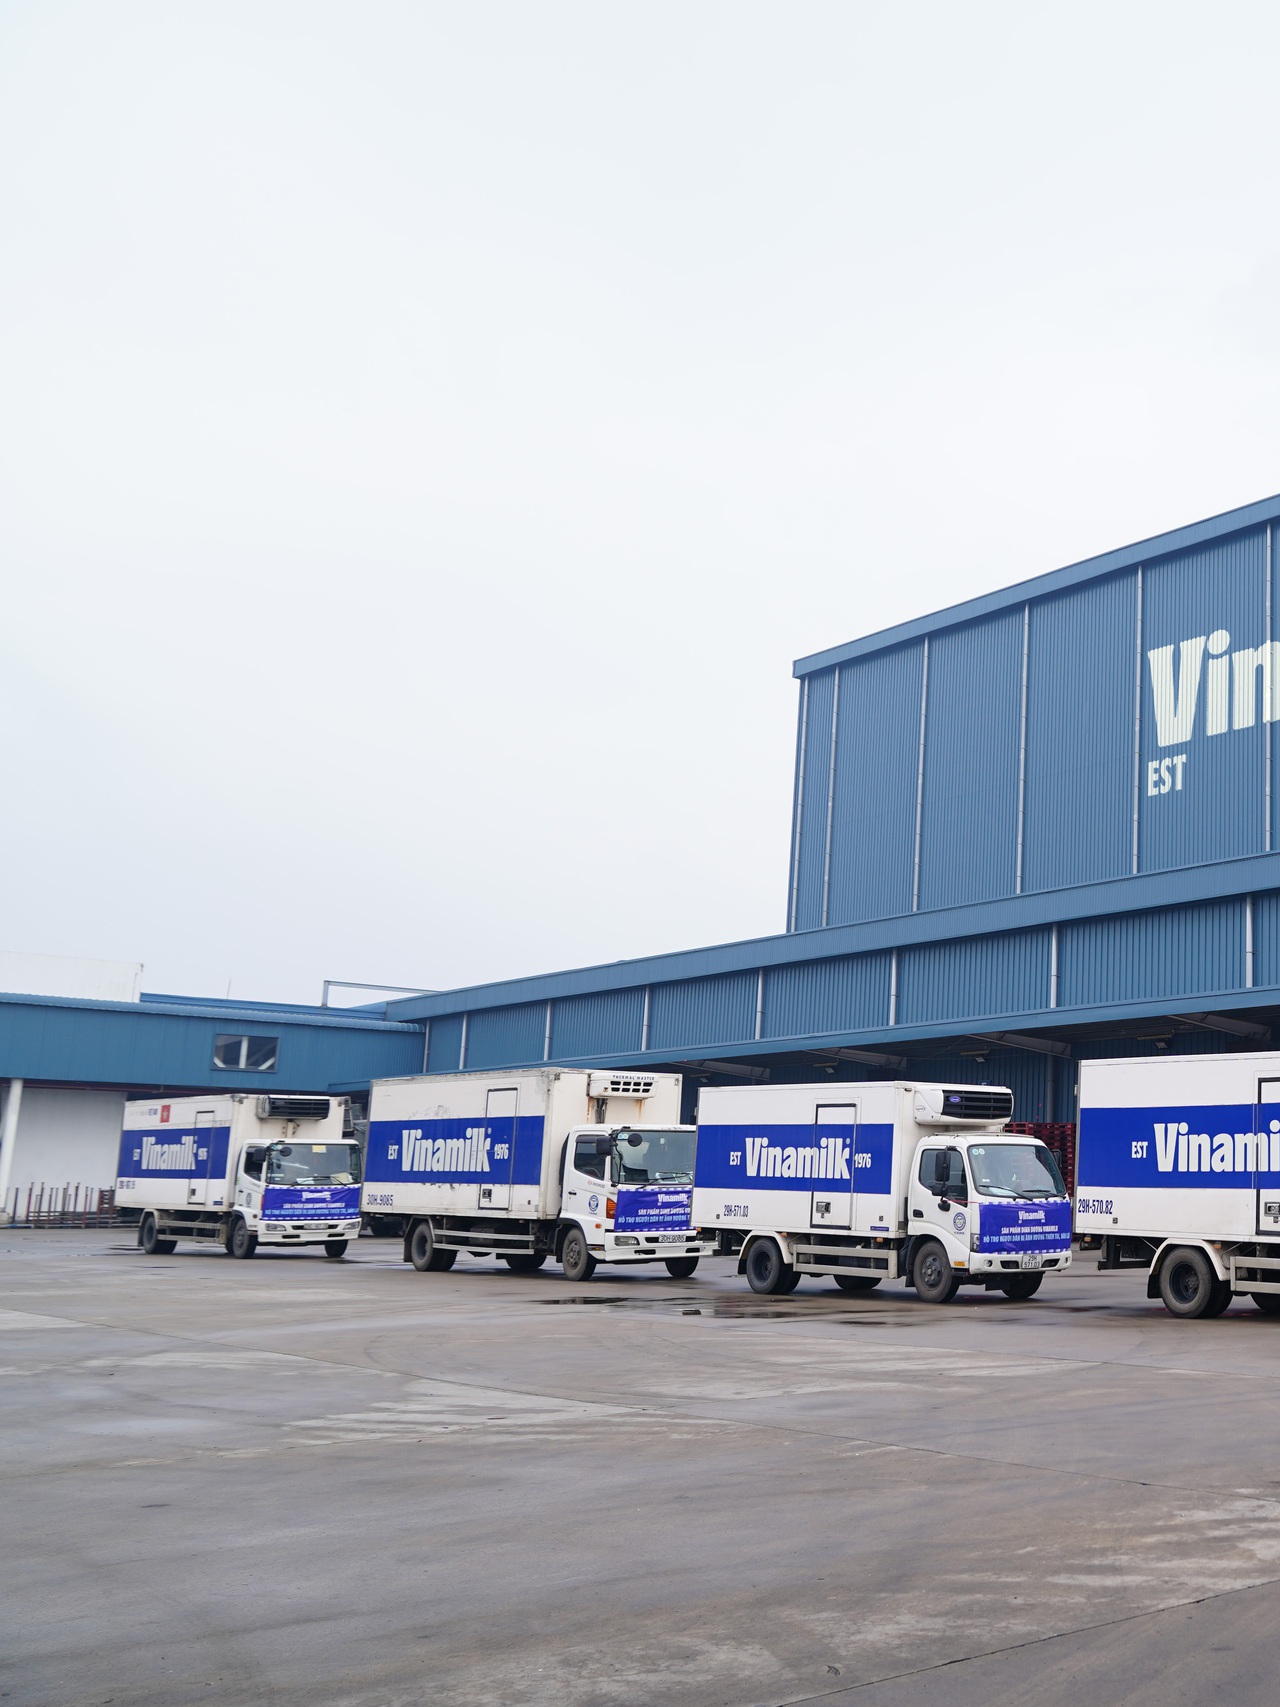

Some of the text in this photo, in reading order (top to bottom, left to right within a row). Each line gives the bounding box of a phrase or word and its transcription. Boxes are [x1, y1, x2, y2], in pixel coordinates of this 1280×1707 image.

[1147, 754, 1187, 797] EST
[141, 1135, 197, 1170] Vinamilk
[388, 1145, 399, 1159] EST
[402, 1127, 491, 1172] Vinamilk
[729, 1137, 872, 1179] EST Vinamilk 1976
[1131, 1141, 1148, 1158] EST
[1078, 1199, 1113, 1214] 29H-570.82
